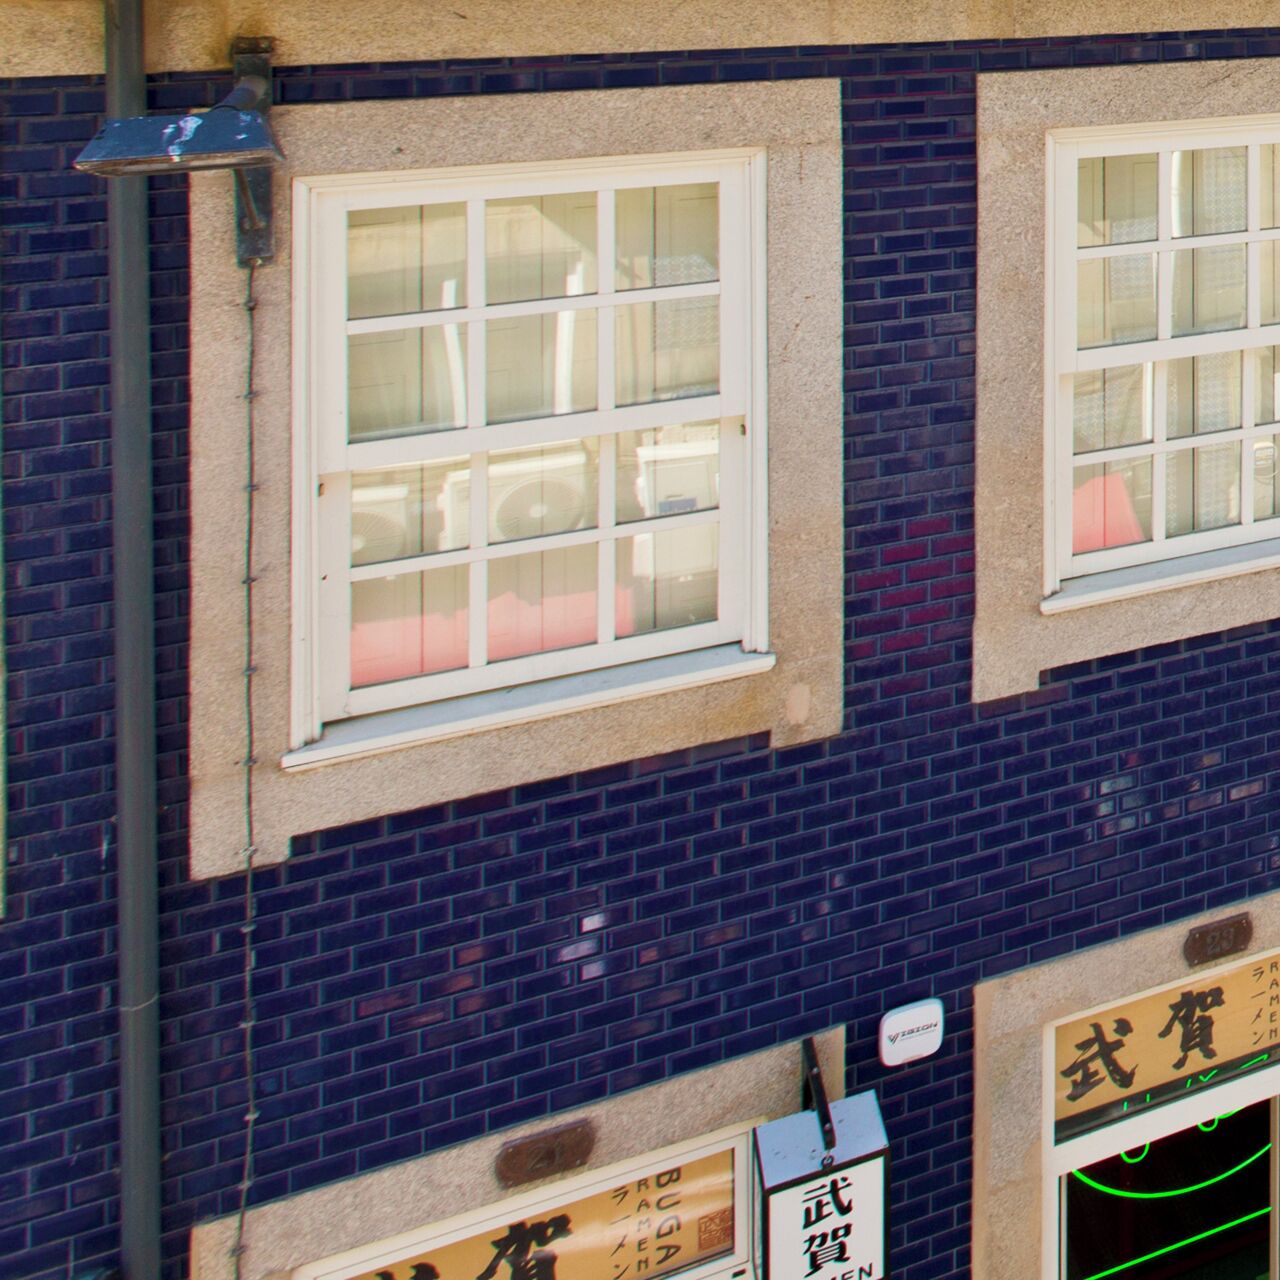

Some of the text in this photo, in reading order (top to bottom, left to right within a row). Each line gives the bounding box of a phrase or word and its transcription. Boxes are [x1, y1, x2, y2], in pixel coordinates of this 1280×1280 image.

[1060, 986, 1226, 1102] 武賀
[1250, 966, 1266, 1045] ラーメン
[1269, 961, 1280, 1040] RAMEN
[636, 1179, 651, 1272] RAMEN
[656, 1167, 682, 1265] BUGA
[801, 1176, 854, 1279] 武賀
